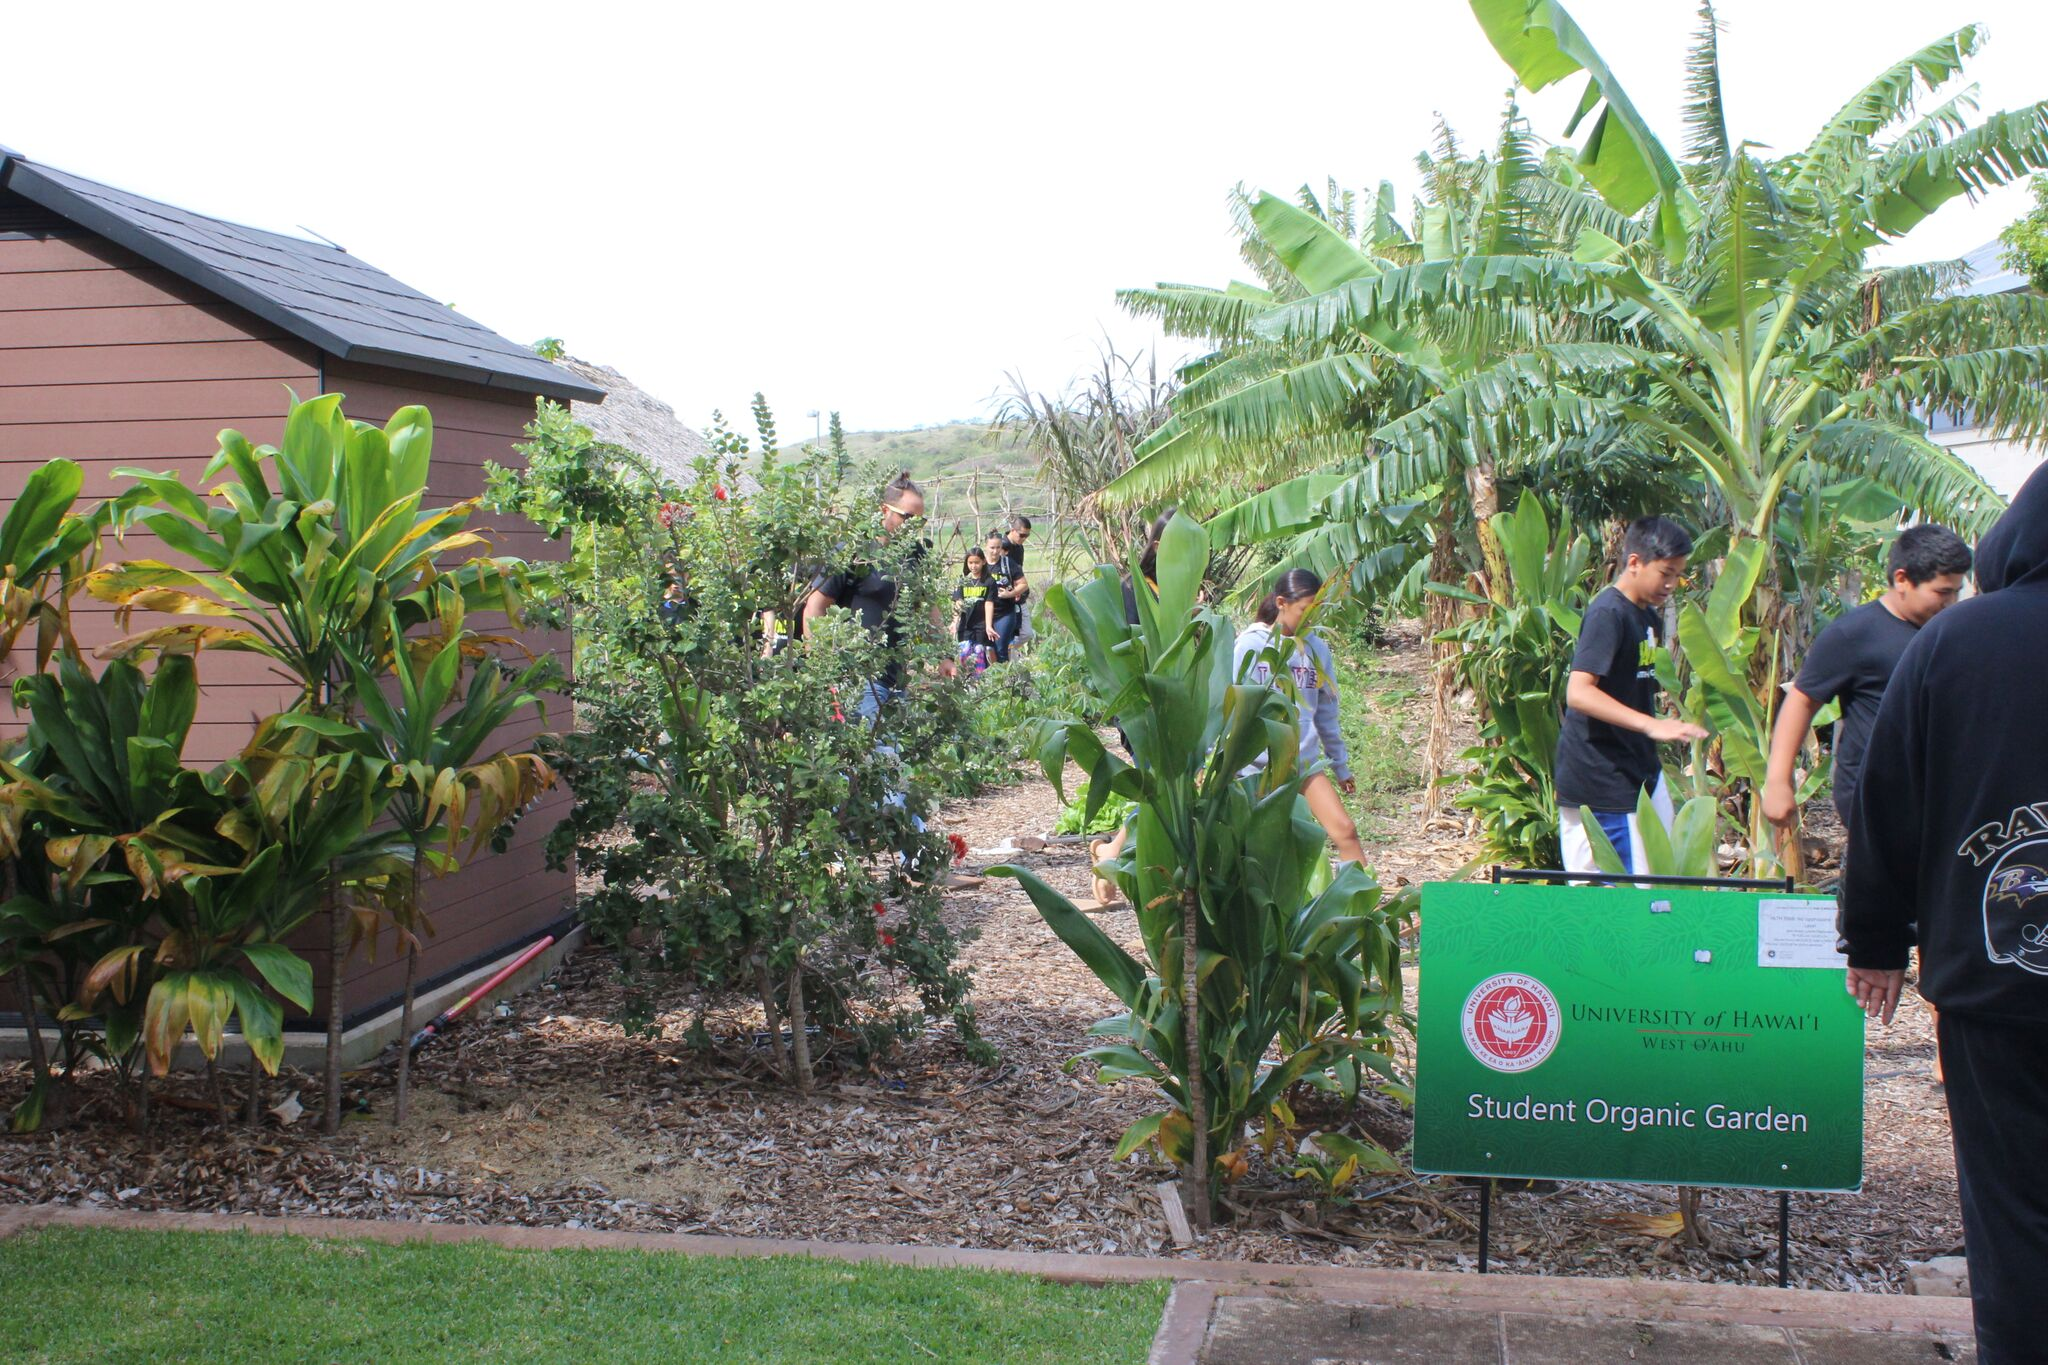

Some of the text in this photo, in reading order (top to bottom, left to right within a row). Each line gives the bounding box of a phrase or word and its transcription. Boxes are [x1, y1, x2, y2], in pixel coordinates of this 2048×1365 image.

[1467, 977, 1513, 1014] UNIVERSITY
[1516, 978, 1530, 986] OF
[1572, 1003, 1696, 1026] UNIVERSITY
[1704, 1009, 1726, 1028] of
[1642, 1035, 1689, 1052] WEST
[1467, 1093, 1808, 1133] Student Organic Garden
